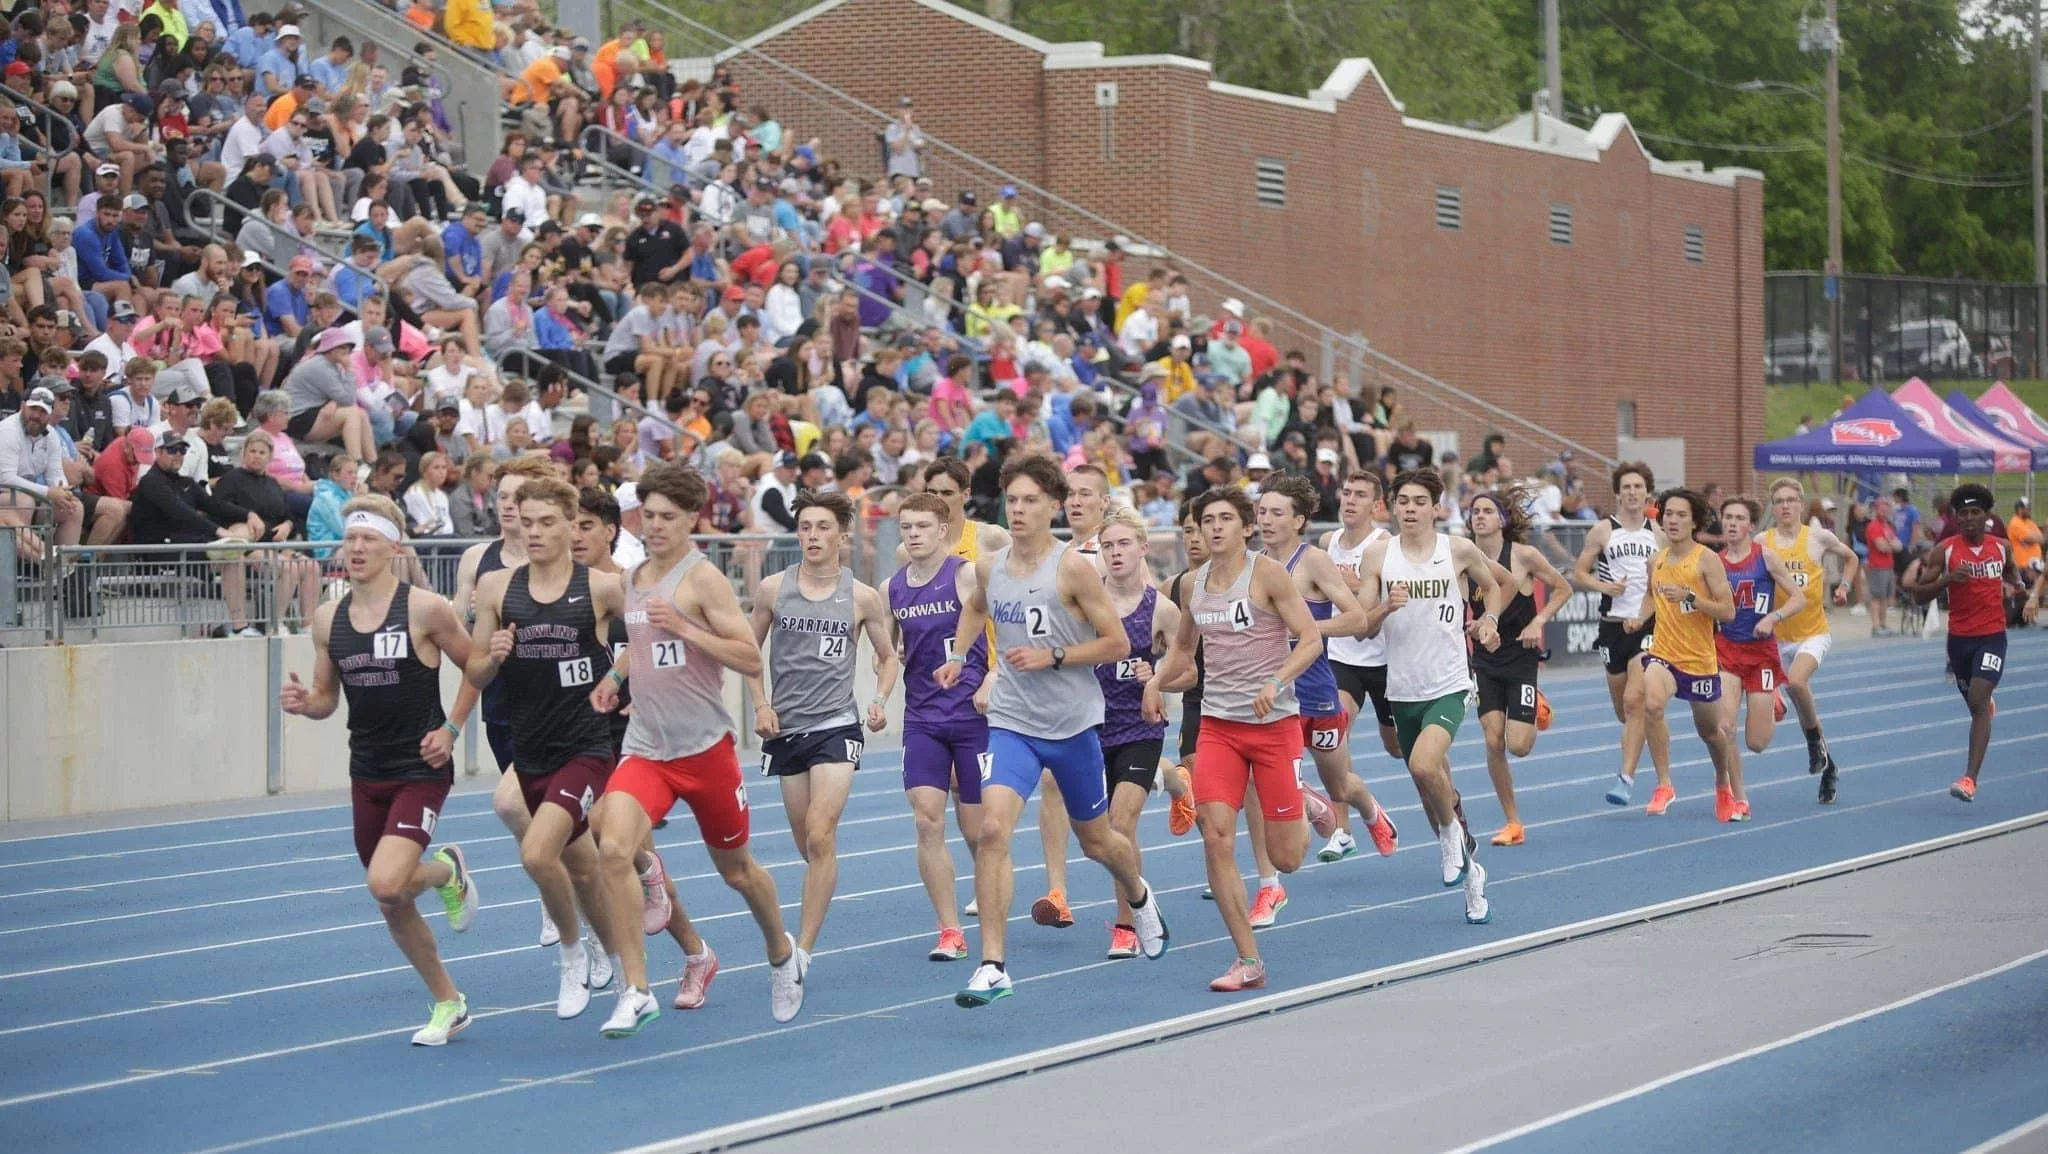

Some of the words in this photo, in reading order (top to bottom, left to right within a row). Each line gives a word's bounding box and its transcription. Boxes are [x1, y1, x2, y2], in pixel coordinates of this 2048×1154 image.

[1815, 454, 1847, 466] SCHOOL
[1848, 454, 1886, 467] ATHLETIC
[1887, 456, 1942, 468] ASSOCIATION
[1610, 543, 1657, 561] JAGUAR
[1991, 563, 2002, 577] 14
[1386, 579, 1450, 599] KNNEDY
[893, 600, 957, 620] NORWALK
[1438, 603, 1455, 623] 10
[1759, 594, 1767, 613] 7
[1029, 607, 1047, 636] 2
[1234, 601, 1249, 627] 4
[516, 623, 580, 643] DOWLING
[781, 616, 849, 635] SPARTANS
[380, 634, 401, 657] 17
[516, 643, 581, 659] CATHOLIC
[656, 641, 679, 667] 21
[823, 637, 844, 657] 24
[1988, 655, 2000, 669] 14
[566, 660, 590, 685] 18
[1763, 671, 1771, 689] 7
[1524, 686, 1534, 705] 8
[1696, 680, 1711, 693] 16
[1315, 731, 1335, 748] 22
